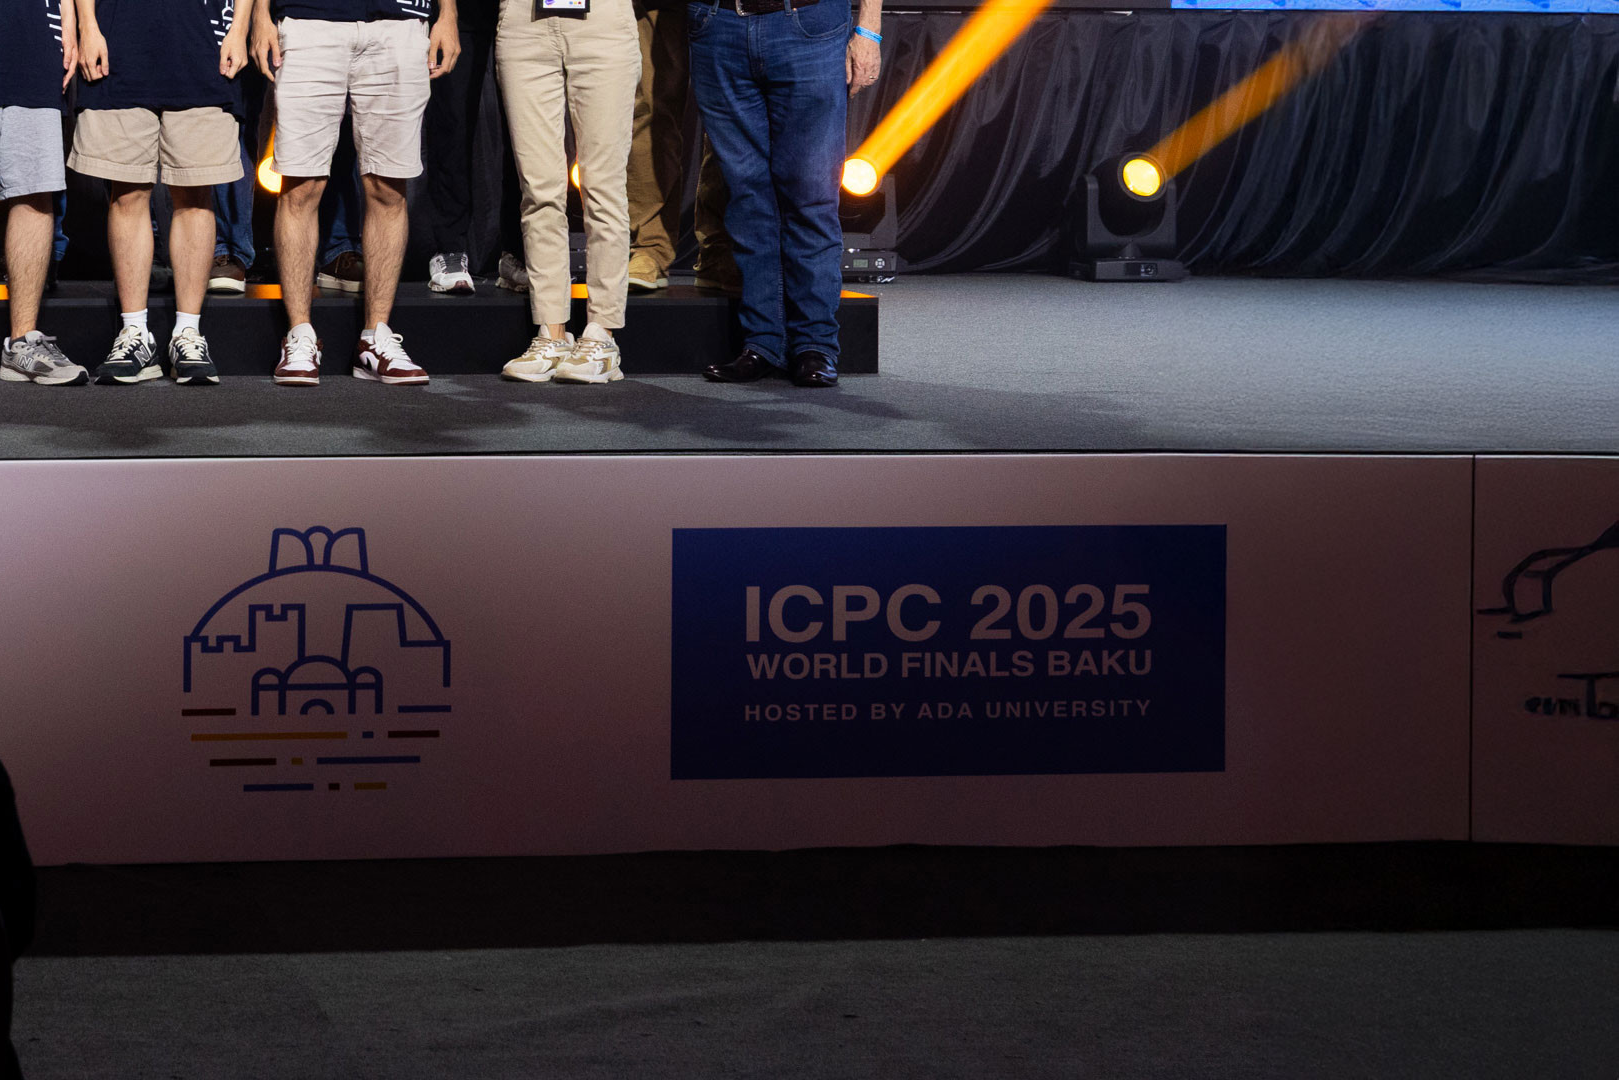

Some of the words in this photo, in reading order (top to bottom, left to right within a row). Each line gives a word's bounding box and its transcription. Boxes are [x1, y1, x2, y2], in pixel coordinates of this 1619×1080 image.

[745, 584, 942, 642] ICPC
[970, 583, 1152, 640] 2025
[746, 652, 888, 680] WORLD
[901, 650, 1035, 678] FINALS
[1047, 649, 1152, 677] BAKU
[745, 703, 857, 723] HOSTED
[871, 702, 906, 721] BY
[917, 701, 973, 720] ADA
[986, 699, 1152, 719] UNIVERSITY
